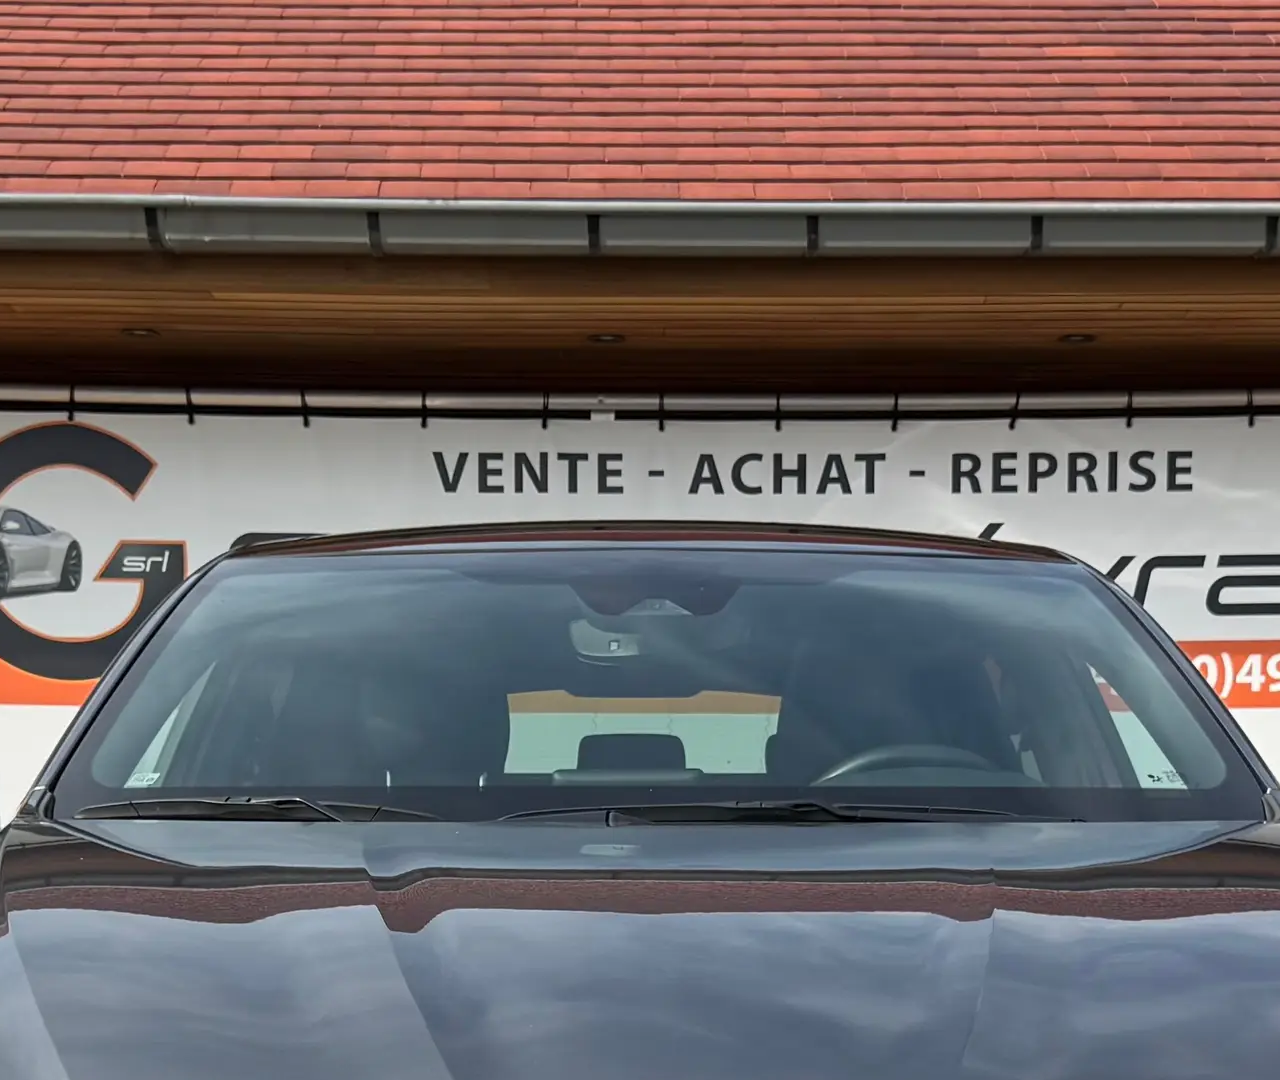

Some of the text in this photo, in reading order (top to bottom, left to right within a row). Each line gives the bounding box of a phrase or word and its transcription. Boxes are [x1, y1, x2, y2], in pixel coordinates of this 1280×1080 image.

[432, 450, 625, 495] VENTE
[688, 451, 887, 496] ACHAT
[951, 449, 1194, 494] REPRISE
[121, 549, 170, 573] srl
